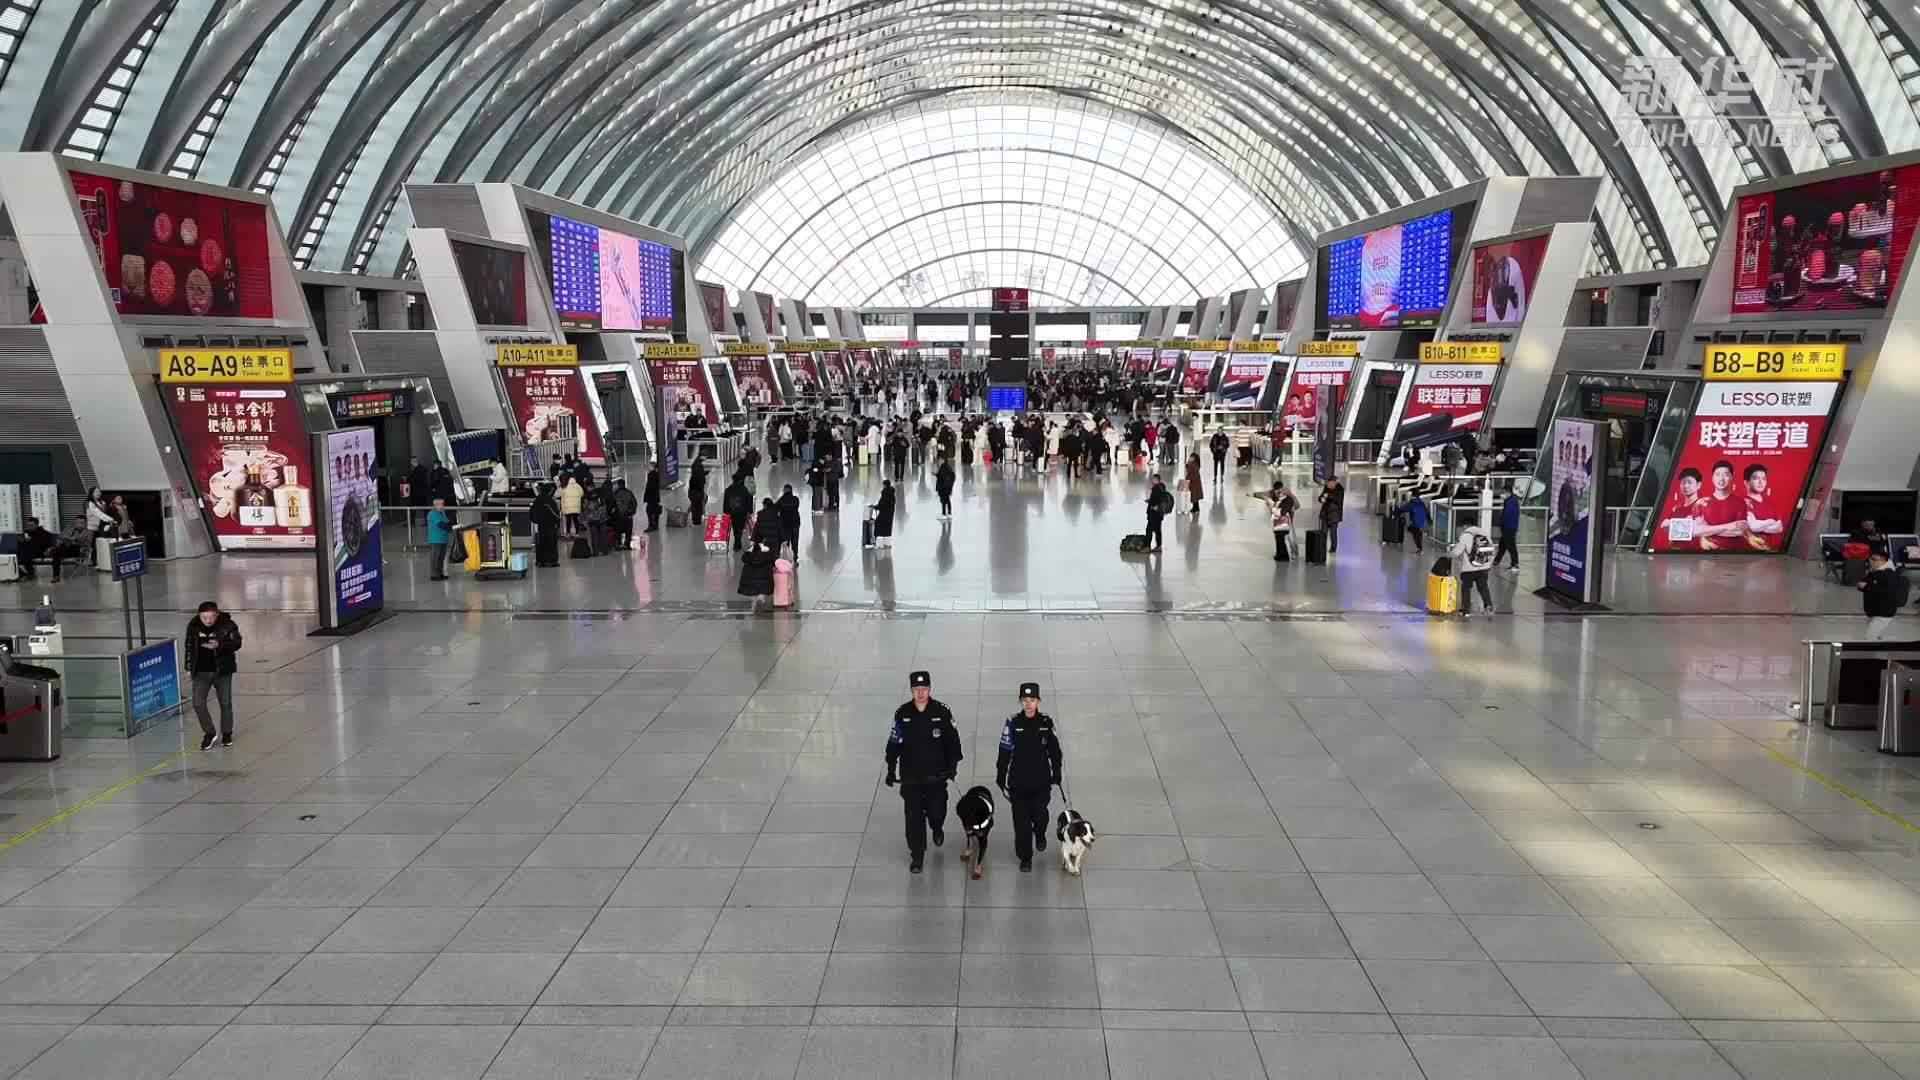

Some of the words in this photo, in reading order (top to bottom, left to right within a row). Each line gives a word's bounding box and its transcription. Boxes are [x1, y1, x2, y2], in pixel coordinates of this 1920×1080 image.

[502, 349, 545, 362] A10-A11
[1301, 343, 1333, 353] B12-B13
[1424, 346, 1467, 359] B10-B11
[168, 354, 239, 377] A8-A9
[242, 355, 284, 369] 检票口
[1712, 351, 1785, 374] B8-B9
[1791, 351, 1836, 364] 检票口
[1417, 387, 1482, 405] 联塑管道
[207, 401, 276, 418] 过年要舍得
[1699, 421, 1809, 449] 联塑管道
